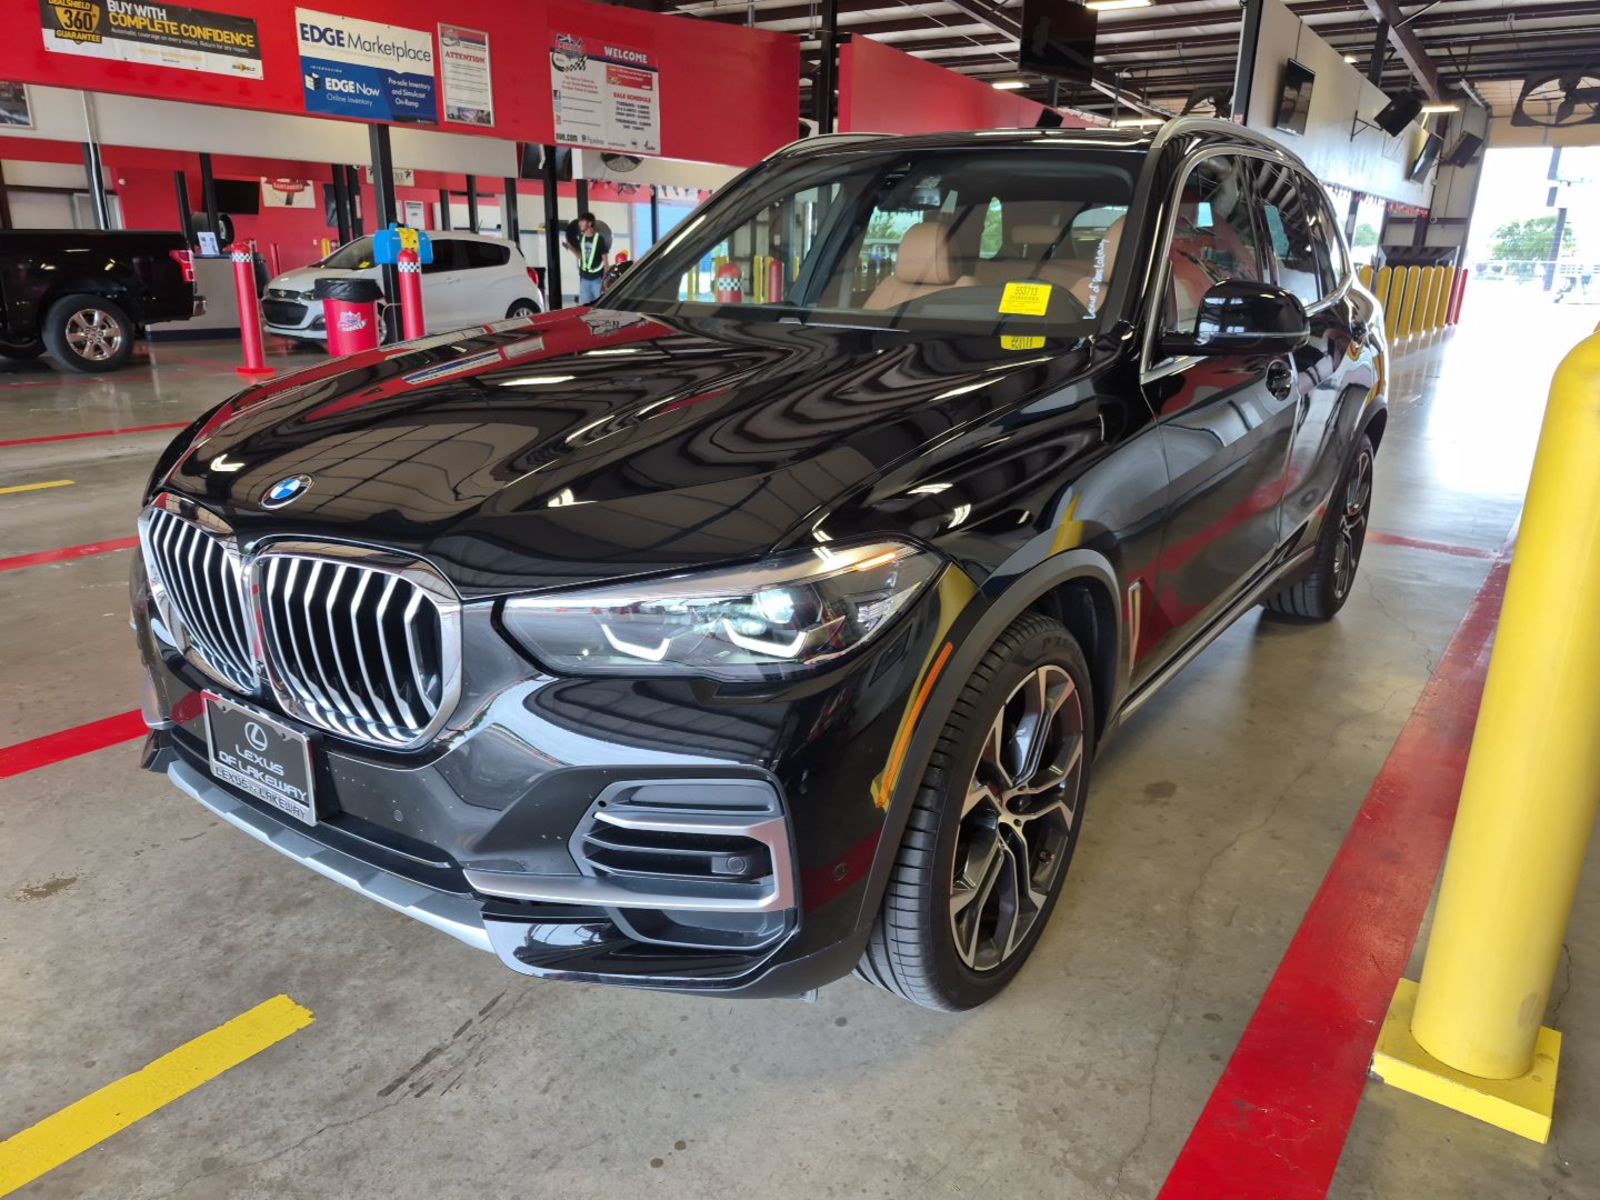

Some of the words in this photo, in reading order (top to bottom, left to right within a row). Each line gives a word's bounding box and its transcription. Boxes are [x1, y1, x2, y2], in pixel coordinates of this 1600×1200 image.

[106, 0, 135, 15] BUY
[134, 4, 167, 20] WITH
[63, 9, 93, 31] 360
[56, 30, 101, 42] GUARANTEE
[109, 12, 179, 35] COMPLETE
[180, 24, 256, 48] CONFIDENCE
[299, 22, 345, 47] EDGE
[347, 32, 432, 62] Marketplace
[445, 51, 485, 64] ATTENTION
[604, 46, 648, 64] WELCOME
[325, 77, 355, 93] EDGE
[356, 81, 380, 96] Now
[391, 88, 402, 96] and
[408, 80, 431, 90] Inventory
[326, 92, 347, 103] Online
[347, 95, 373, 107] Inventory
[235, 744, 284, 776] LEXUS
[218, 750, 237, 766] OF
[238, 760, 307, 802] LAKEWAY
[215, 766, 249, 789] LEXUS
[258, 787, 306, 819] LAKEWAY
